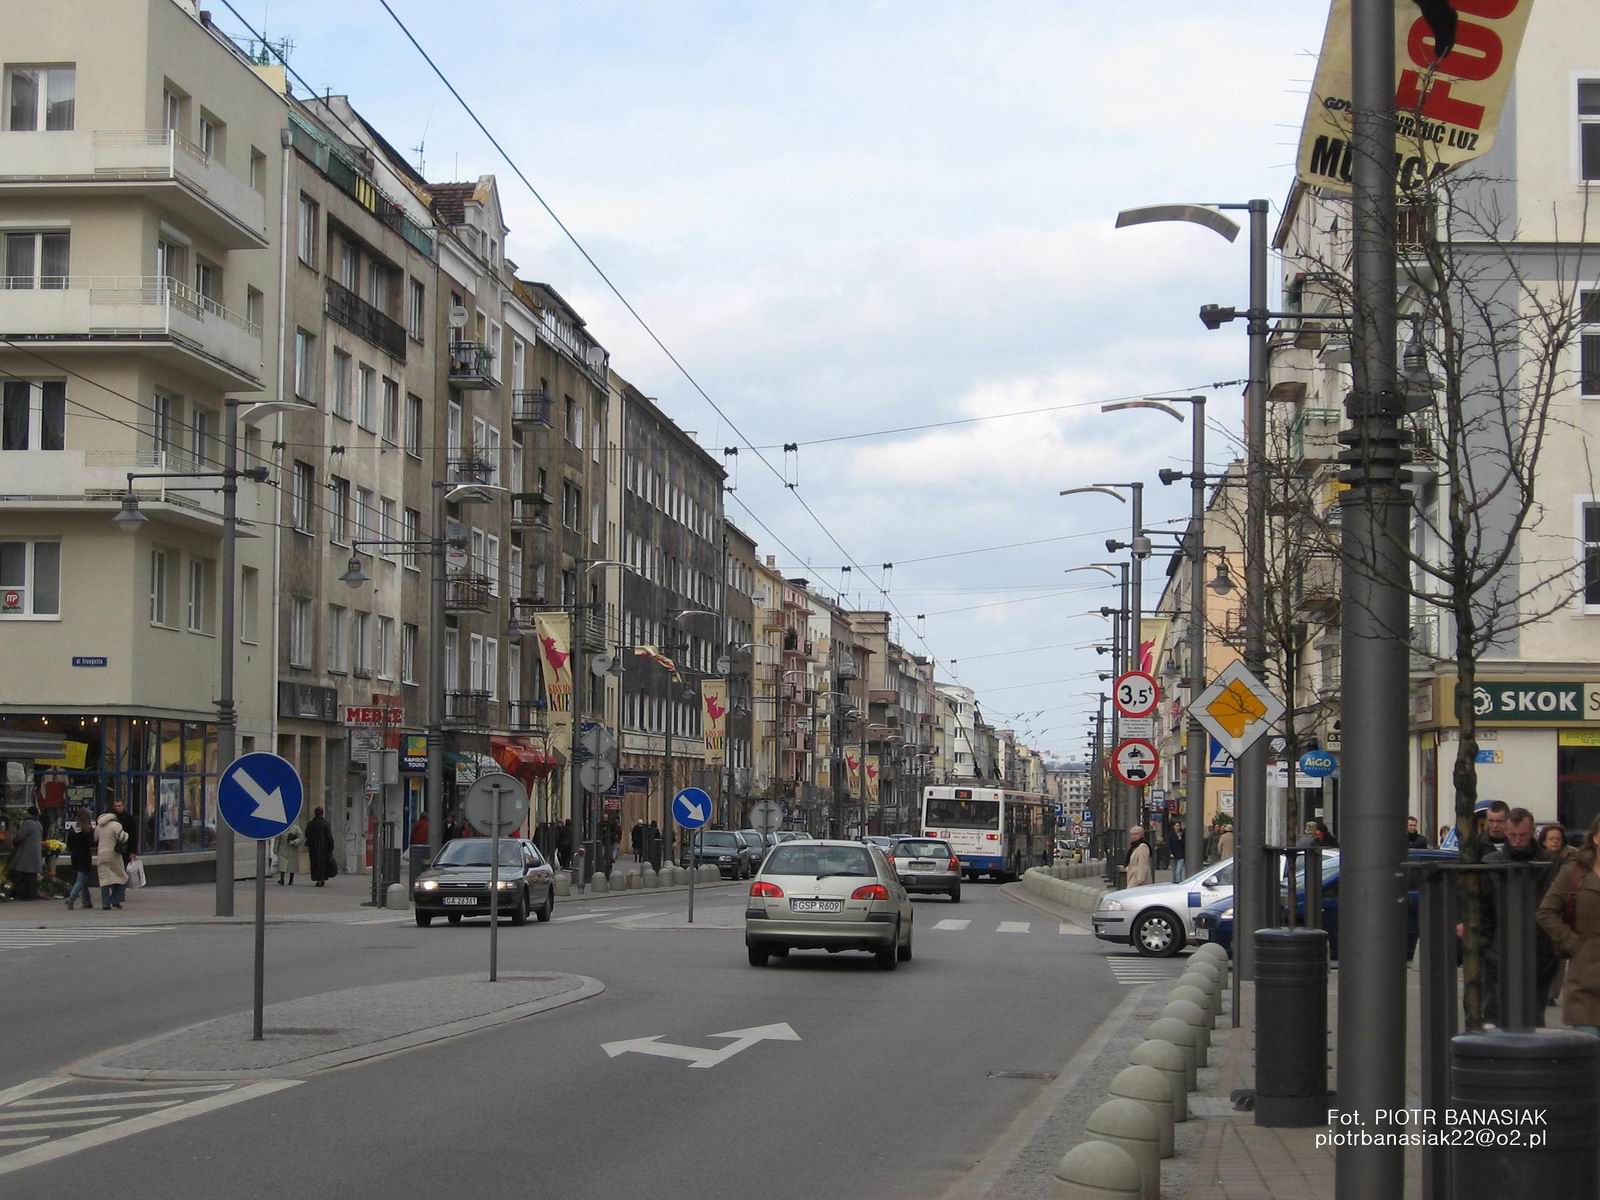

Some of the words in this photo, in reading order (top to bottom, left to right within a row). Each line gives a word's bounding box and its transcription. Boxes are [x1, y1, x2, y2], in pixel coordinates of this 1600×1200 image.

[1447, 128, 1479, 151] LUZ
[1501, 691, 1577, 711] SKOK
[799, 901, 816, 910] GSP
[819, 901, 840, 910] R609
